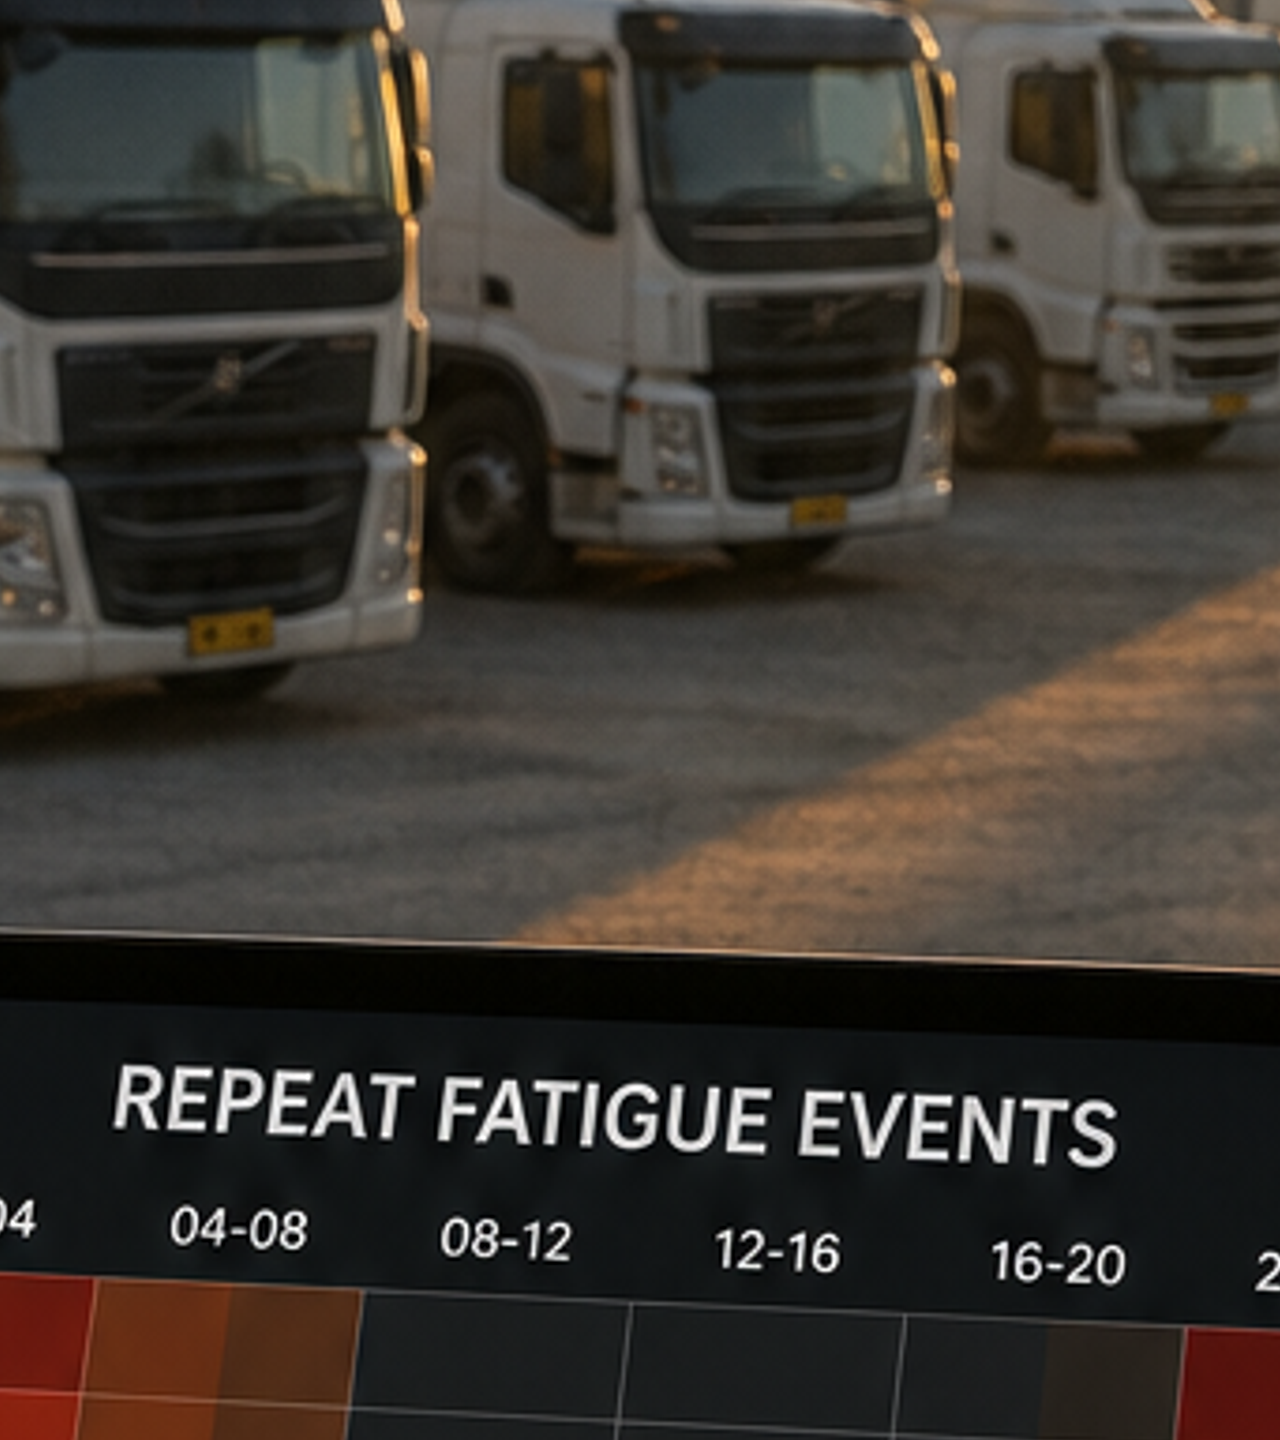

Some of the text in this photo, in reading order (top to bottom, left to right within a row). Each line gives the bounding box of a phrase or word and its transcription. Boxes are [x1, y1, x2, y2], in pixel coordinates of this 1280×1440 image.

[113, 1064, 1117, 1168] REPEAT FATIGUE EVENTS
[170, 1204, 308, 1251] 04-08
[440, 1216, 572, 1262] 08-12
[715, 1228, 840, 1274] 12-16
[992, 1240, 1126, 1286] 16-20
